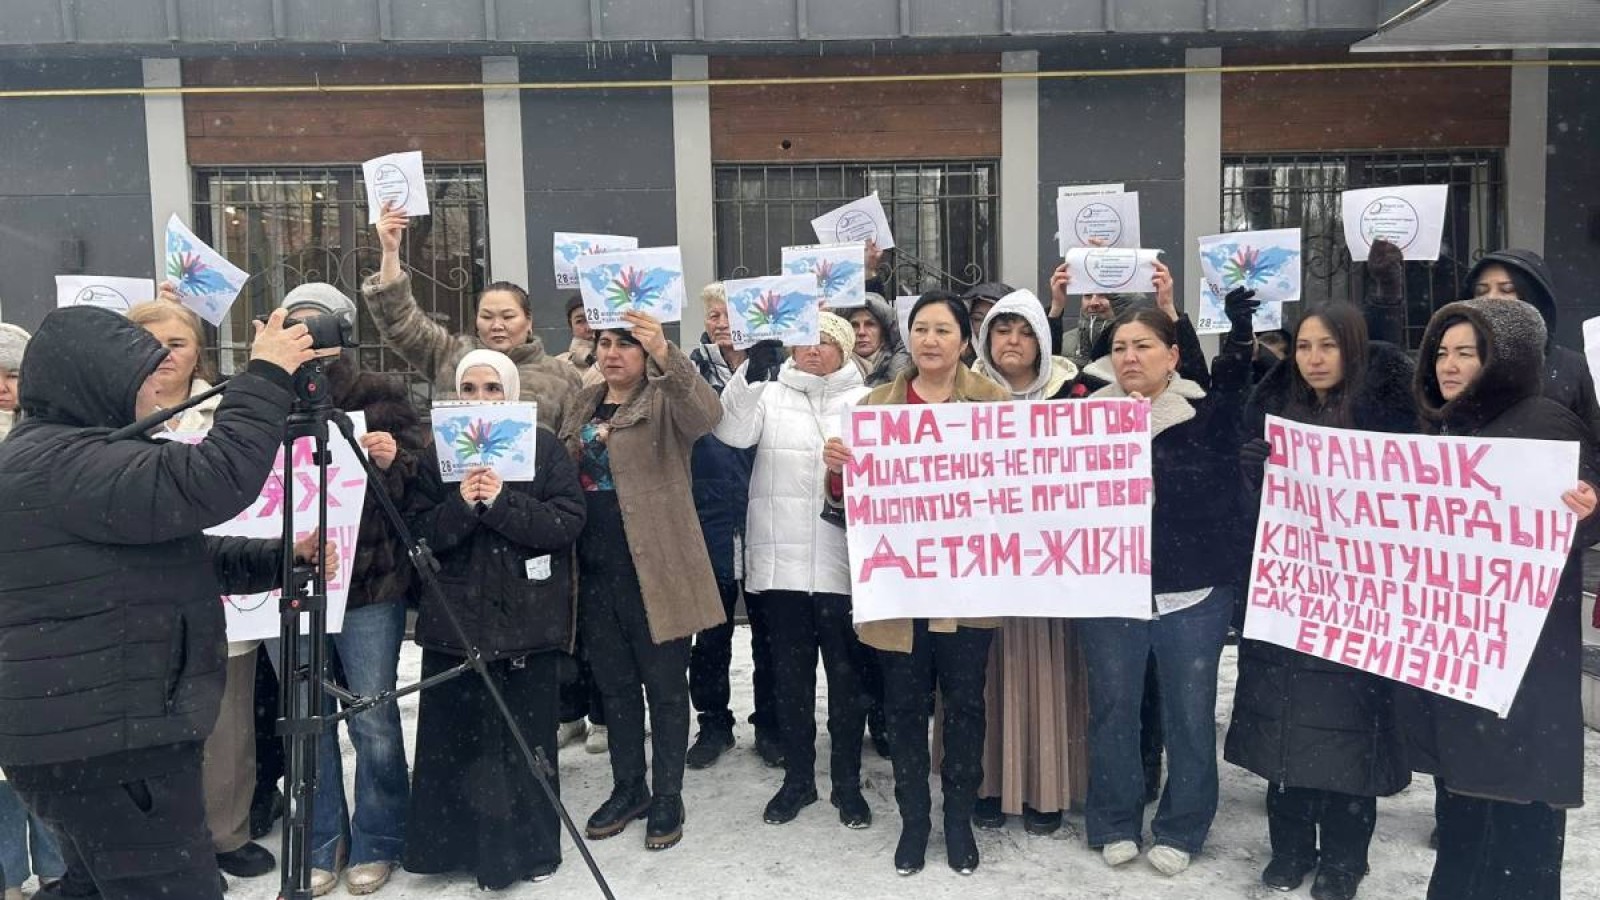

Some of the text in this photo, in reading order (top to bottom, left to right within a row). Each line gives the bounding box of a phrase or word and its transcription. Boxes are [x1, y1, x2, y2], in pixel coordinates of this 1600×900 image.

[586, 308, 599, 321] 28
[1033, 443, 1142, 474] ПРИГОВОР
[1032, 477, 1153, 512] ПРИГОВОР
[1401, 617, 1508, 671] ТАЛАП
